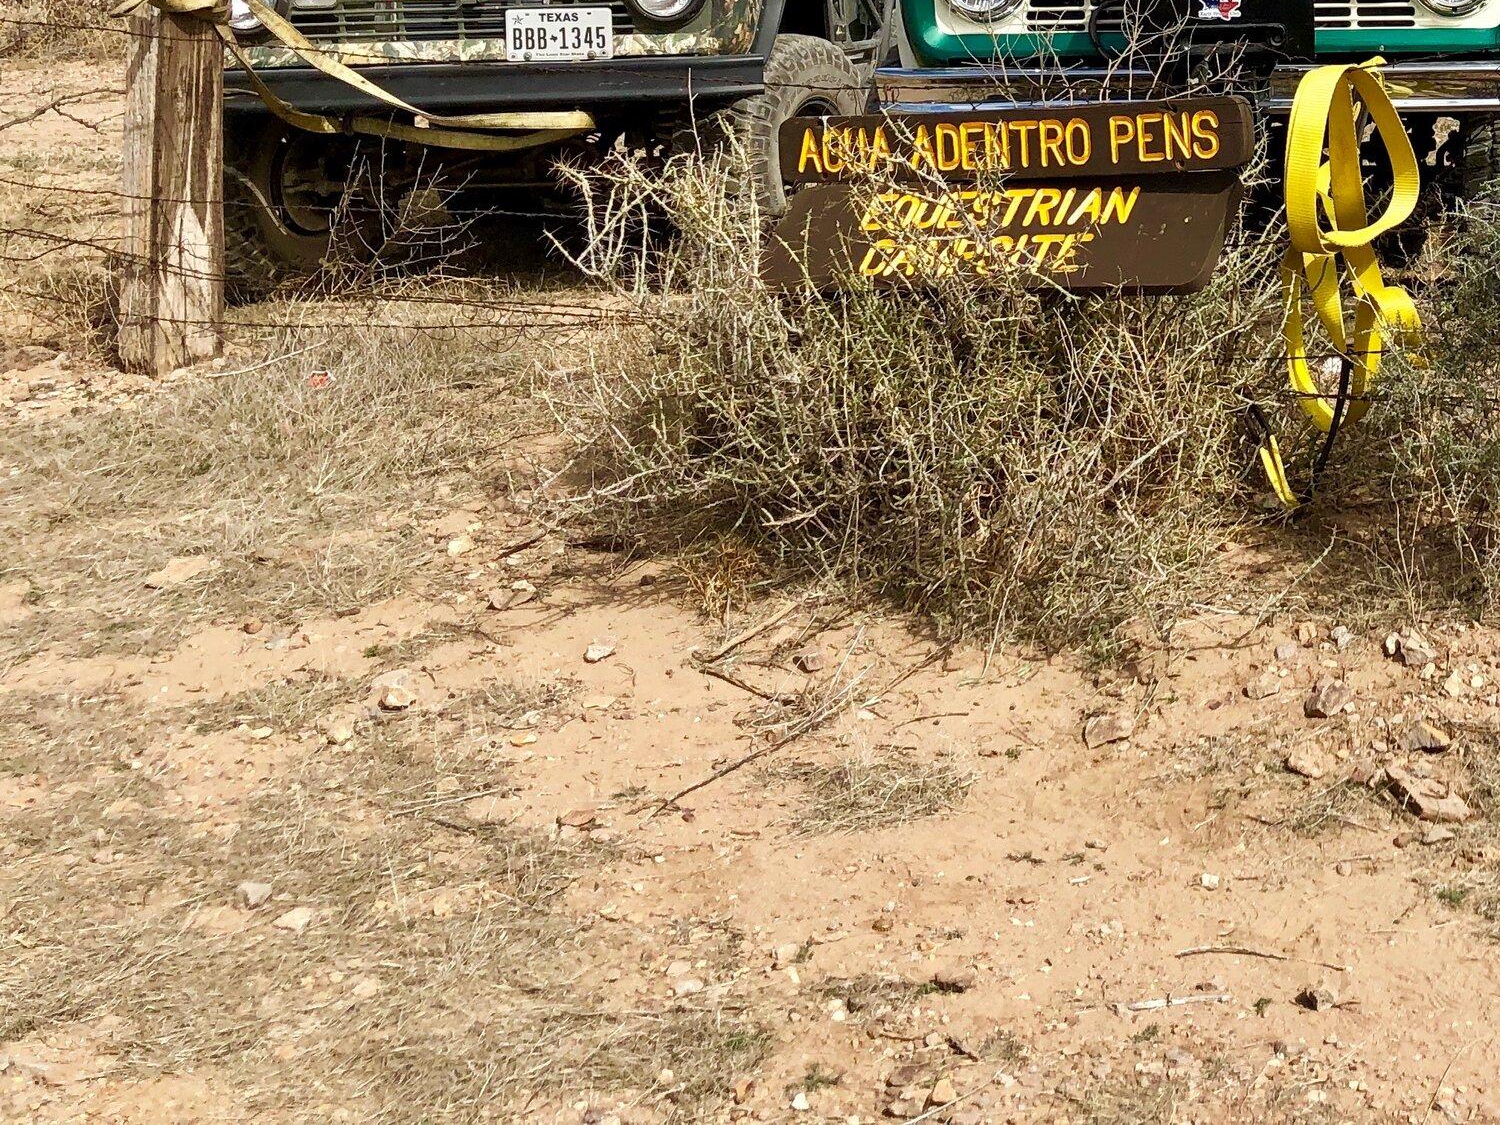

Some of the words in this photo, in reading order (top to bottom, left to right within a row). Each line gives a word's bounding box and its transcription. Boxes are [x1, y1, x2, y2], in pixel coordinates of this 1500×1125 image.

[539, 12, 579, 22] TEXAS
[797, 125, 894, 173] AGUA
[911, 117, 1092, 173] ADENTRO
[1109, 109, 1220, 164] PENS
[858, 186, 1141, 231] EQUESTRIAN
